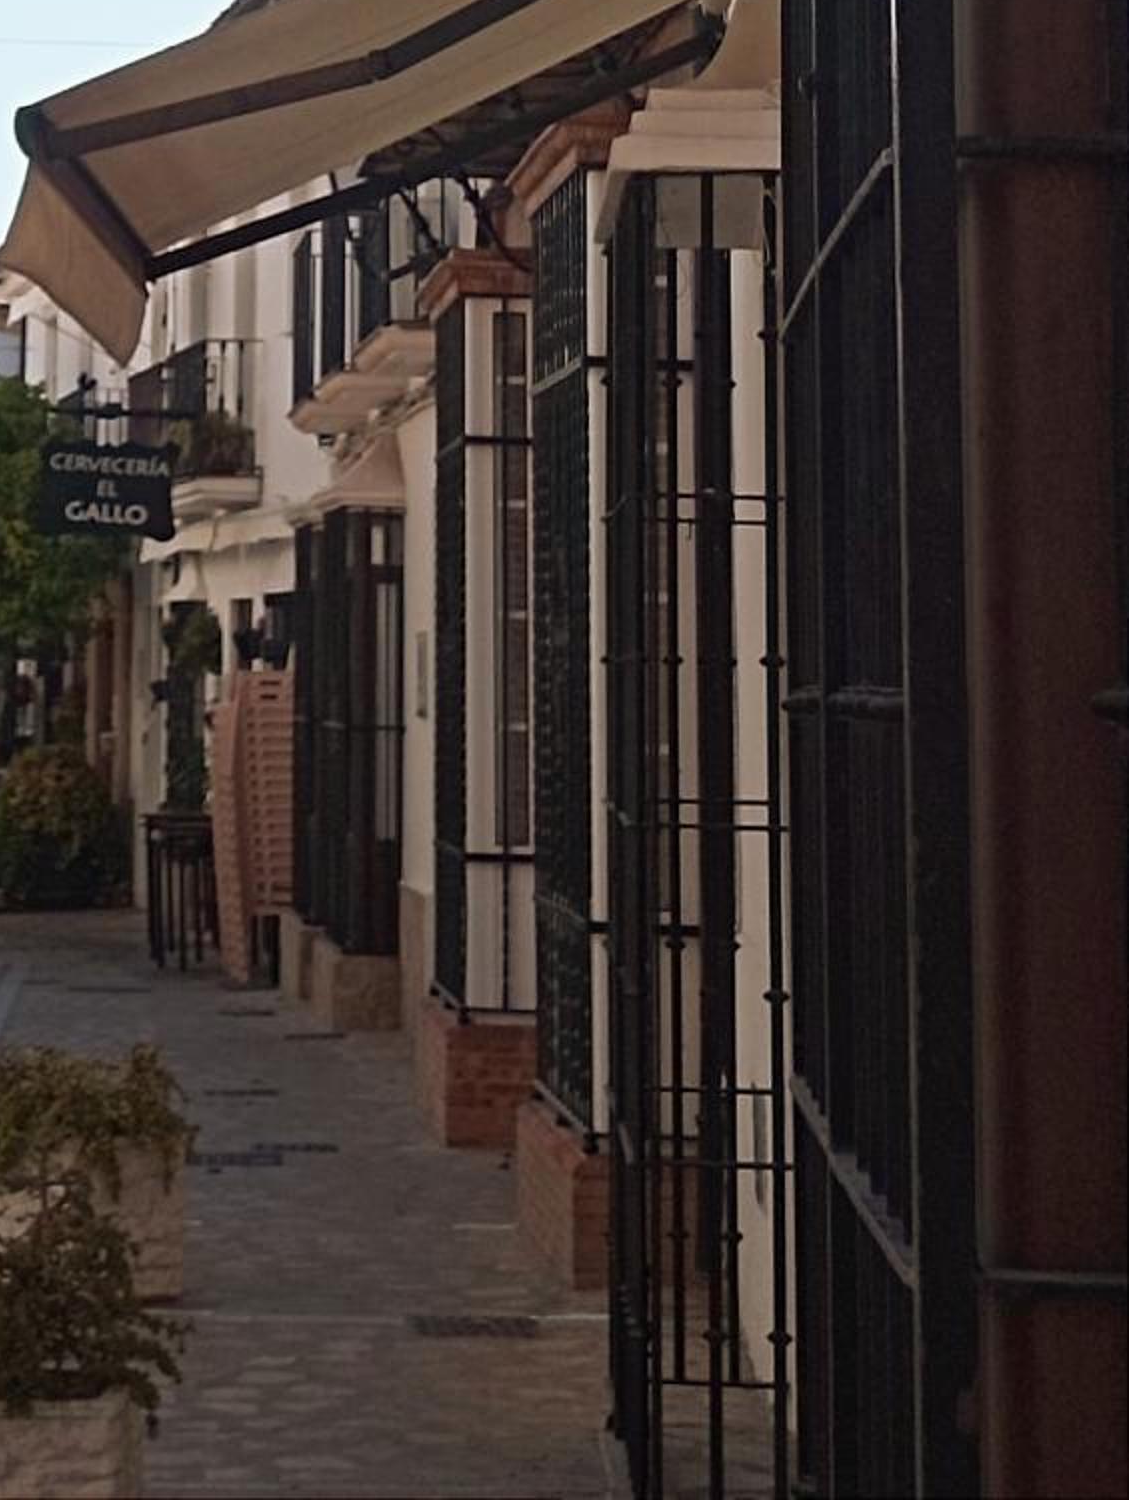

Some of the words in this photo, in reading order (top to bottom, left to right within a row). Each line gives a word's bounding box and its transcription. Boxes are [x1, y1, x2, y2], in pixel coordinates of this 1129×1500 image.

[49, 453, 170, 477] CERVECERÍA
[96, 479, 118, 498] EL
[64, 501, 149, 526] GALLO
